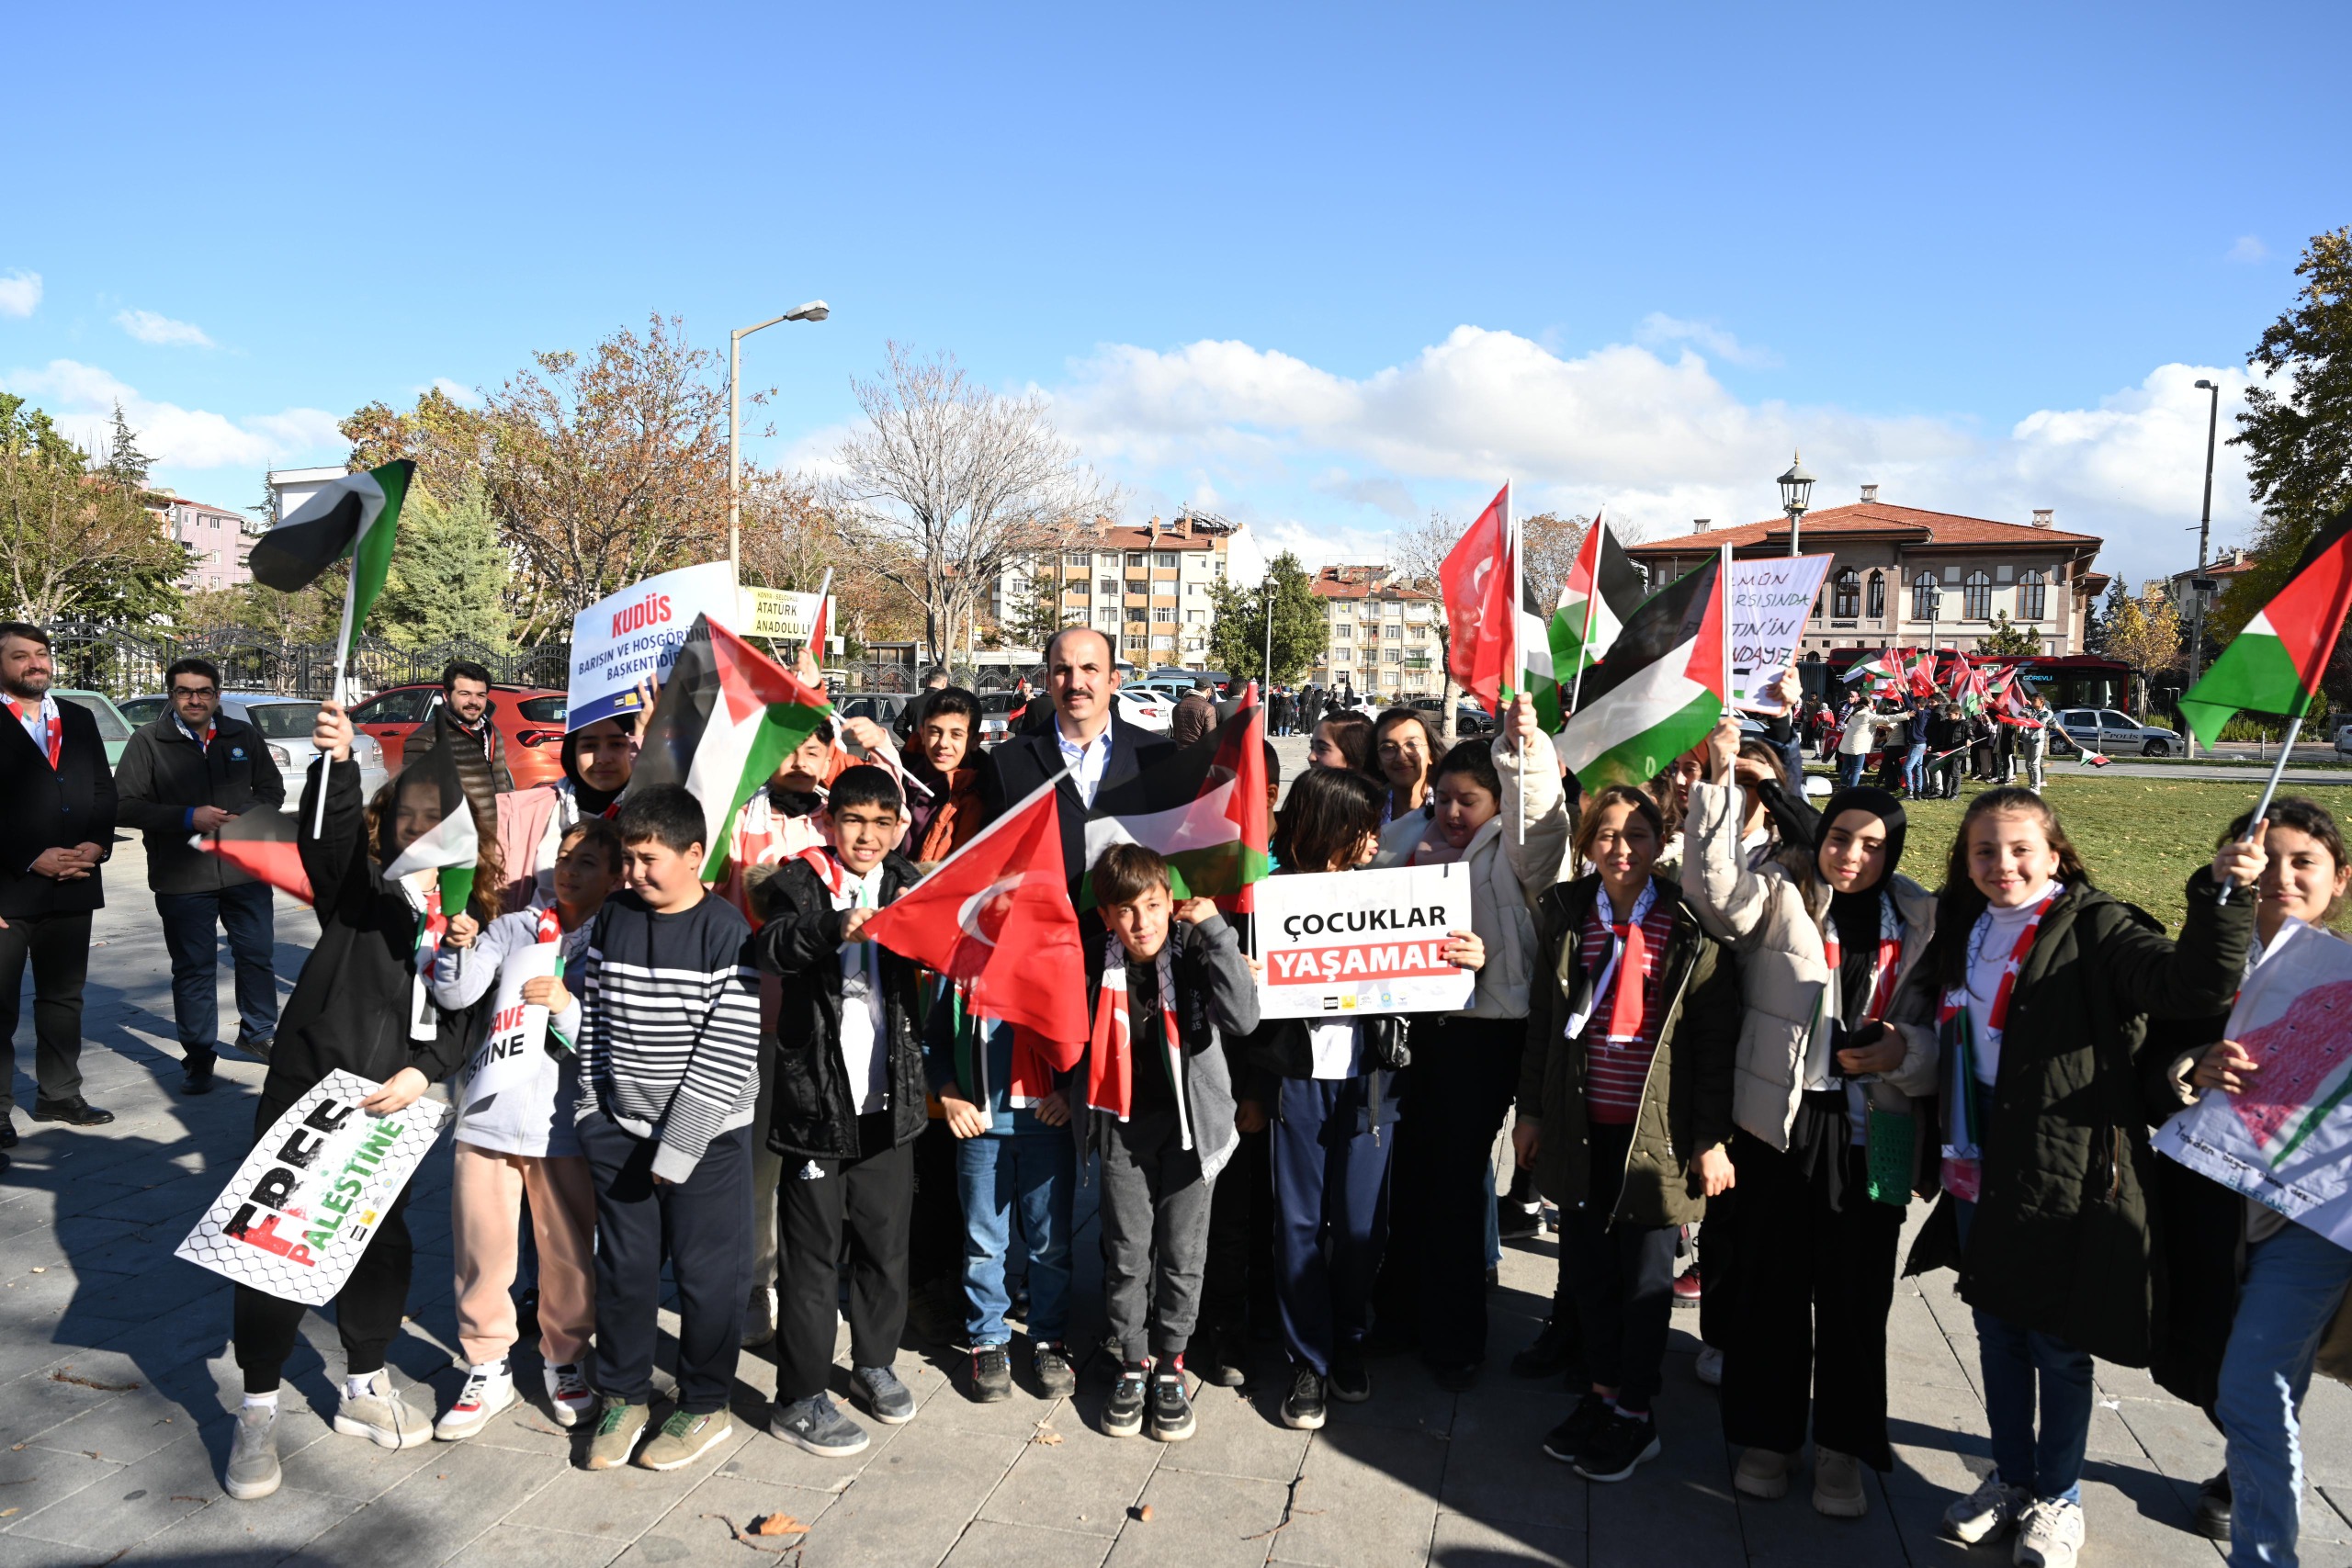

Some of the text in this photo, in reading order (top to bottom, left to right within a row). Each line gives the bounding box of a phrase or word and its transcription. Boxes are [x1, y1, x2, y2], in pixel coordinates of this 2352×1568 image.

[612, 592, 672, 638] KUDÜS
[756, 620, 798, 634] ANADOLU
[757, 602, 797, 616] ATATÜRK
[579, 649, 614, 675] BARIŞIN
[617, 642, 629, 658] VE
[1283, 906, 1446, 942] ÇOCUKLAR
[1273, 943, 1452, 981] YAŞAMAL
[287, 1116, 404, 1267] PALESTINE
